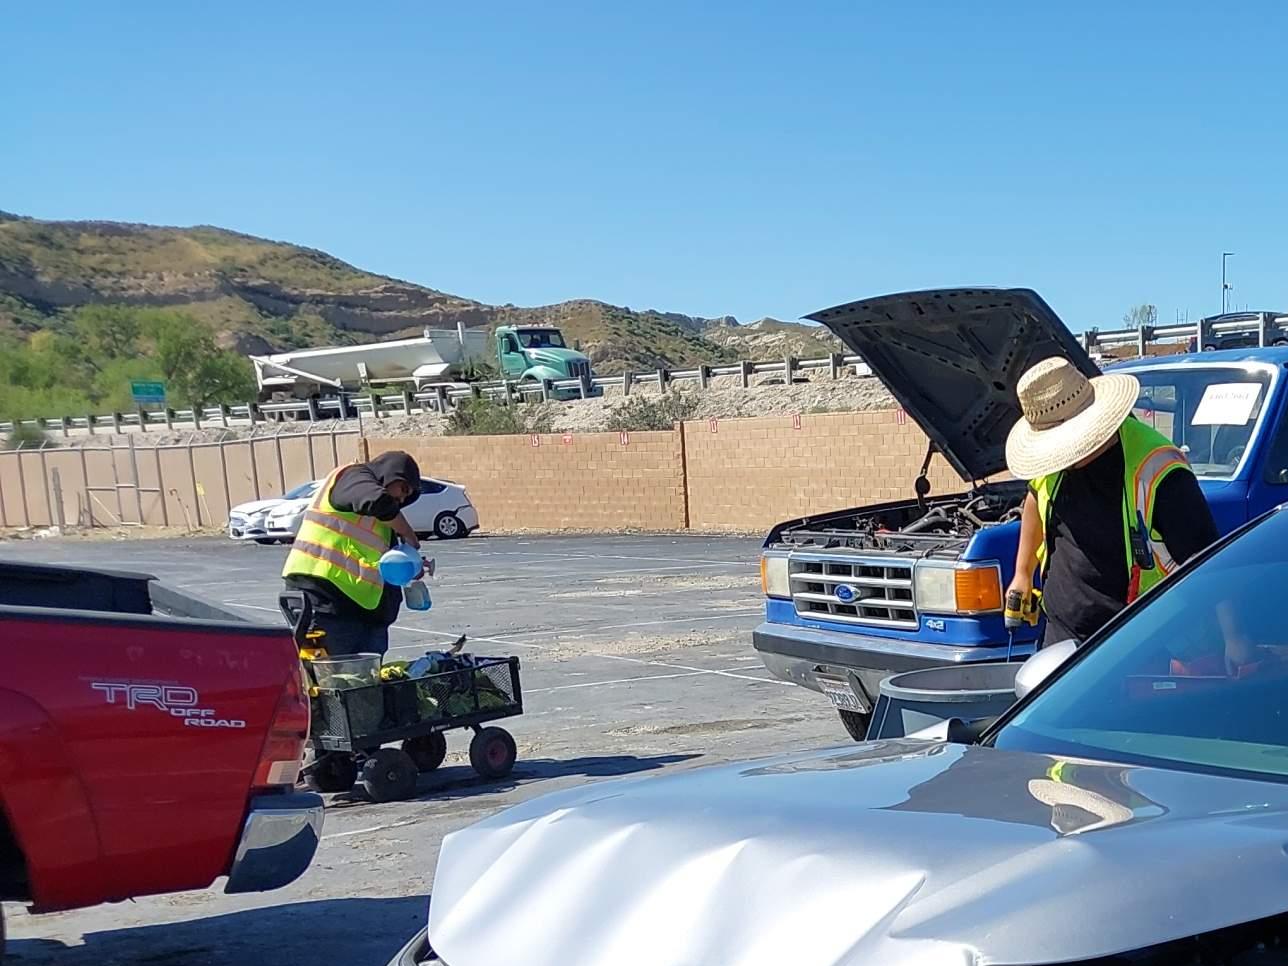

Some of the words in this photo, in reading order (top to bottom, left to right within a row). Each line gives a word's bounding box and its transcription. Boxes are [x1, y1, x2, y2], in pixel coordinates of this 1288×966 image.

[91, 683, 198, 711] TRD
[170, 708, 215, 717] OFF
[184, 718, 246, 728] ROAD
